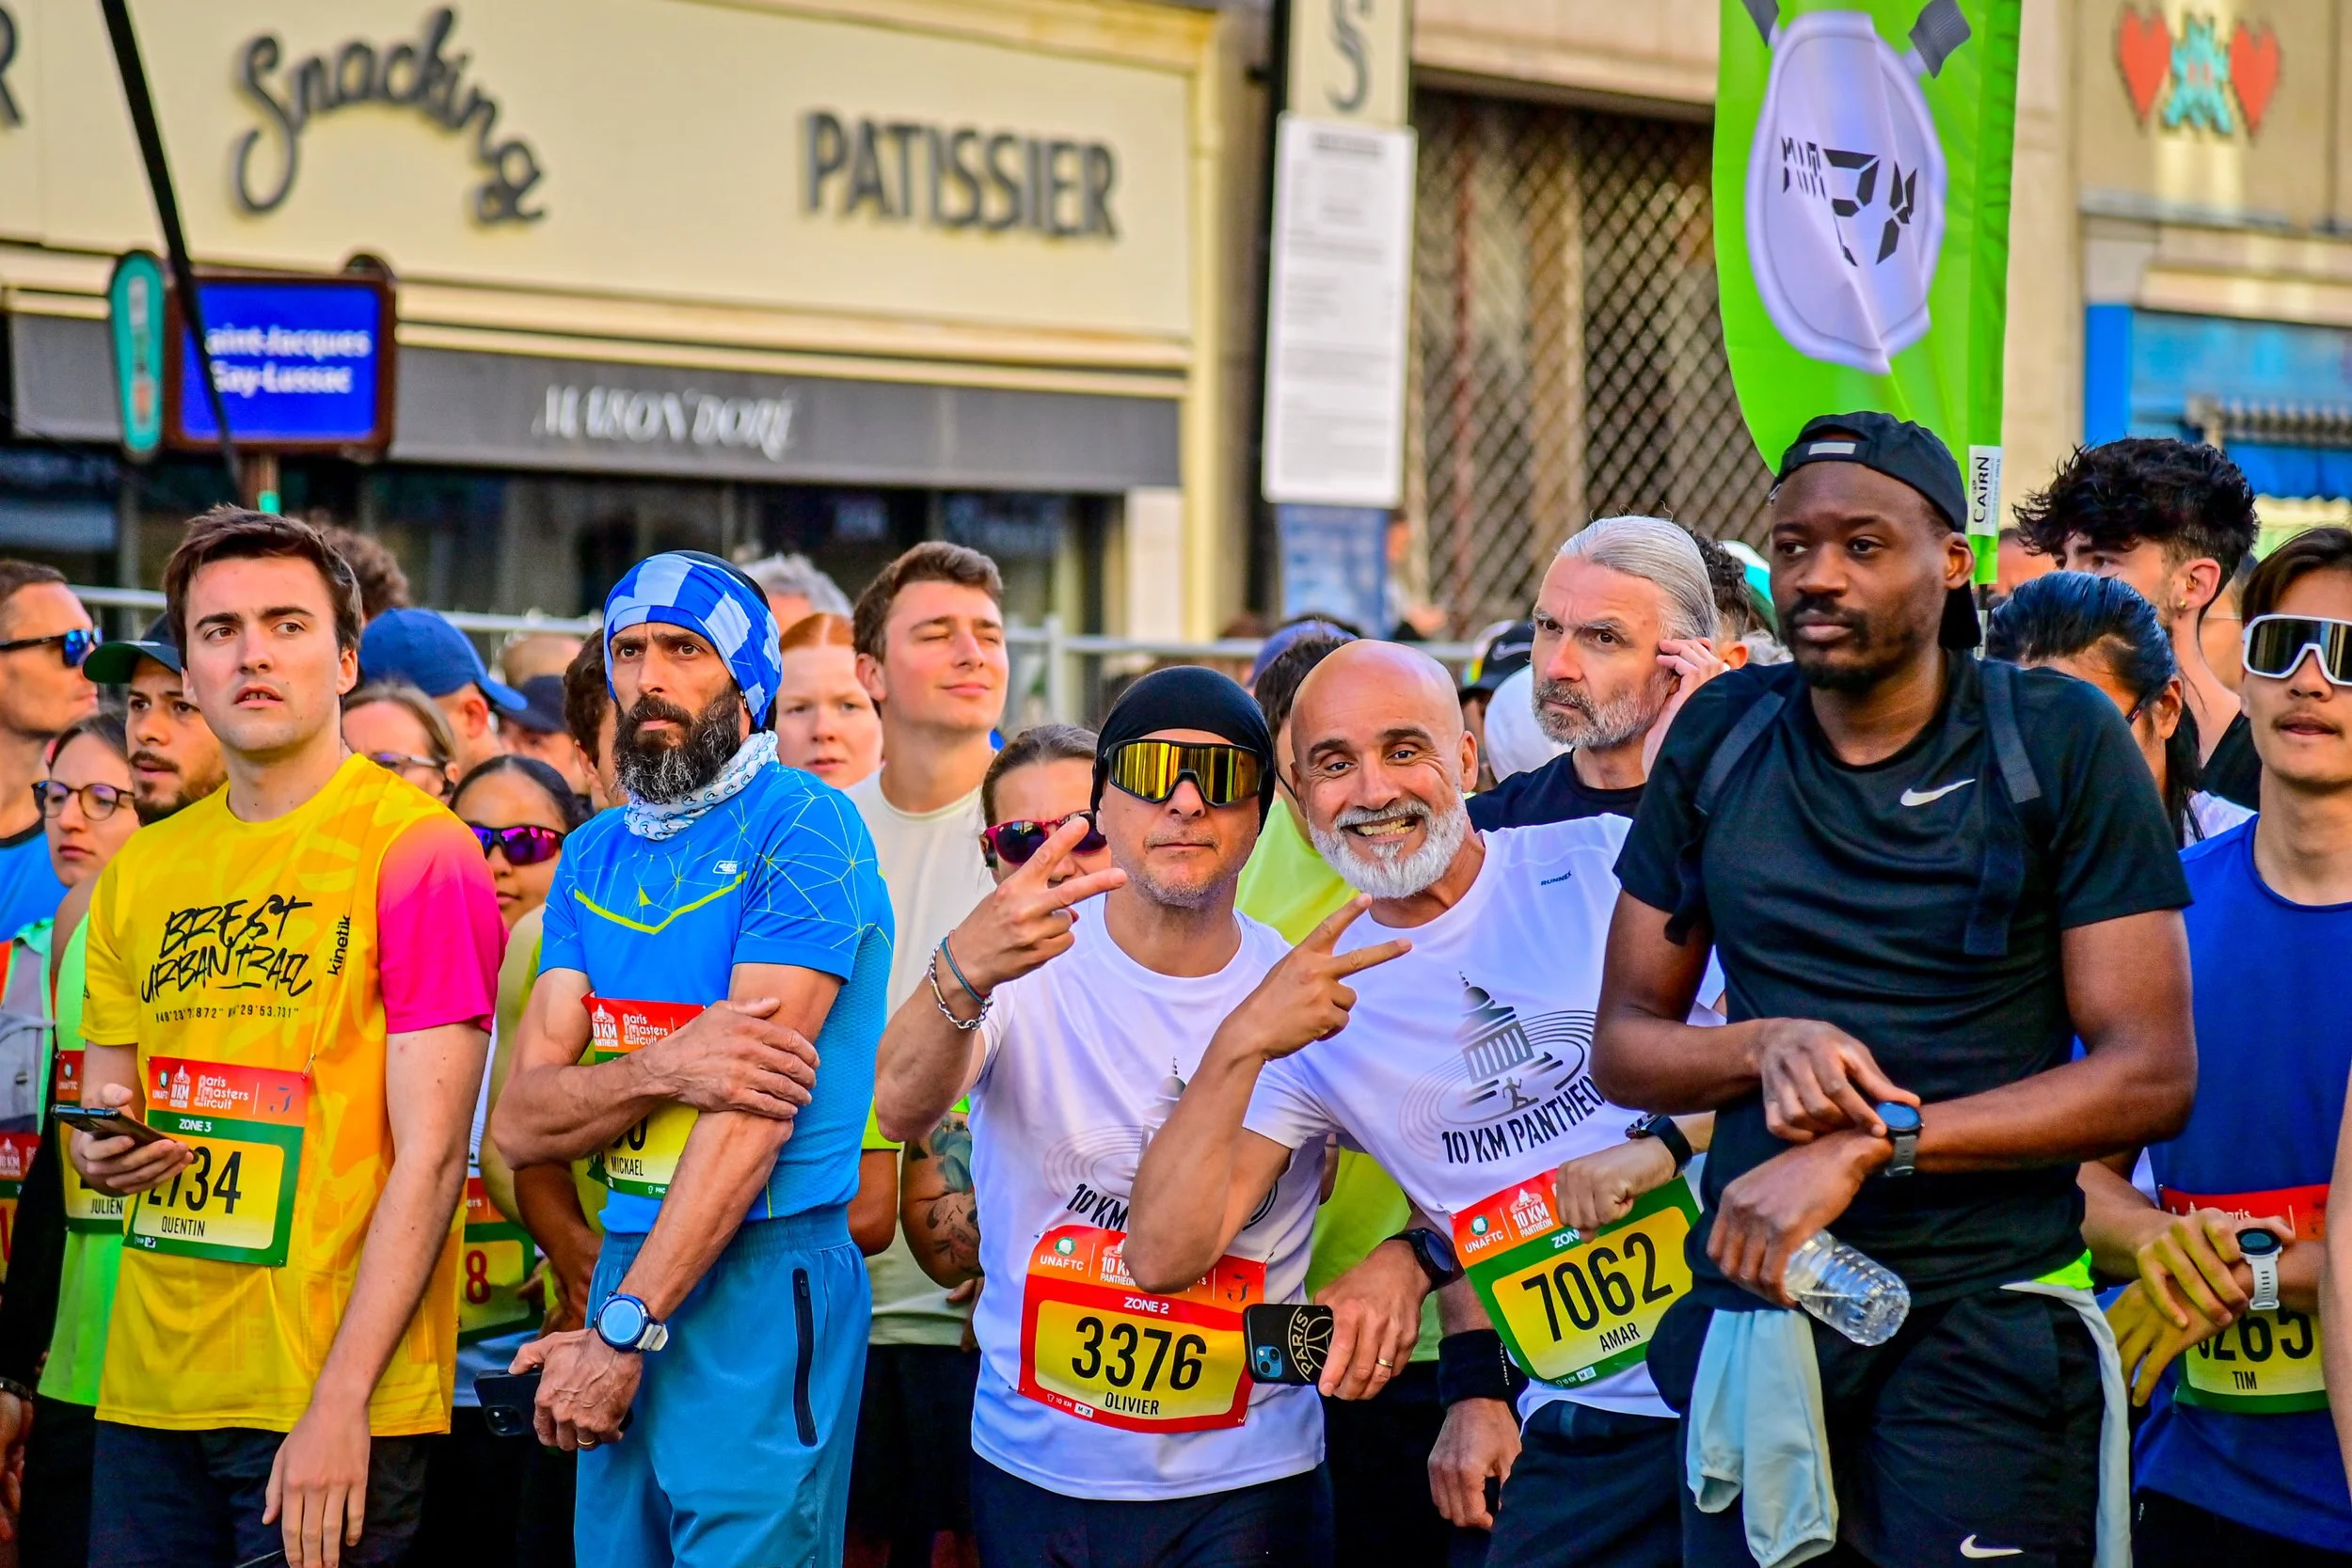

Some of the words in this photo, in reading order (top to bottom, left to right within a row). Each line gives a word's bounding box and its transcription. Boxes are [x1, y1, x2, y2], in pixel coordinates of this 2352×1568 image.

[804, 110, 1119, 240] PATISSIER
[204, 323, 373, 362] aint-Jacques
[158, 894, 313, 958] BREST
[326, 913, 351, 976] kinetik
[179, 1117, 203, 1132] ZONE
[204, 1121, 213, 1133] 3
[1441, 1131, 1470, 1164] 10
[1470, 1124, 1511, 1164] KM
[1506, 1075, 1606, 1154] PANTHEO
[611, 1155, 644, 1177] MICKAEL
[90, 1197, 123, 1215] JULIEN
[1066, 1182, 1098, 1214] 10
[161, 1215, 206, 1237] QUENTIN
[1513, 1211, 1528, 1229] 10
[1527, 1202, 1550, 1224] KM
[1464, 1230, 1504, 1254] UNAFTC
[1551, 1228, 1581, 1249] ZON
[1040, 1254, 1085, 1271] UNAFTC
[1101, 1256, 1116, 1274] 10
[1521, 1231, 1674, 1343] 7062
[1123, 1296, 1158, 1313] ZONE
[1160, 1302, 1169, 1315] 2
[1292, 1312, 1314, 1375] PARIS
[1599, 1322, 1641, 1353] AMAR
[1071, 1316, 1207, 1392] 3376
[2233, 1370, 2258, 1389] TIM
[1104, 1391, 1160, 1416] OLIVIER
